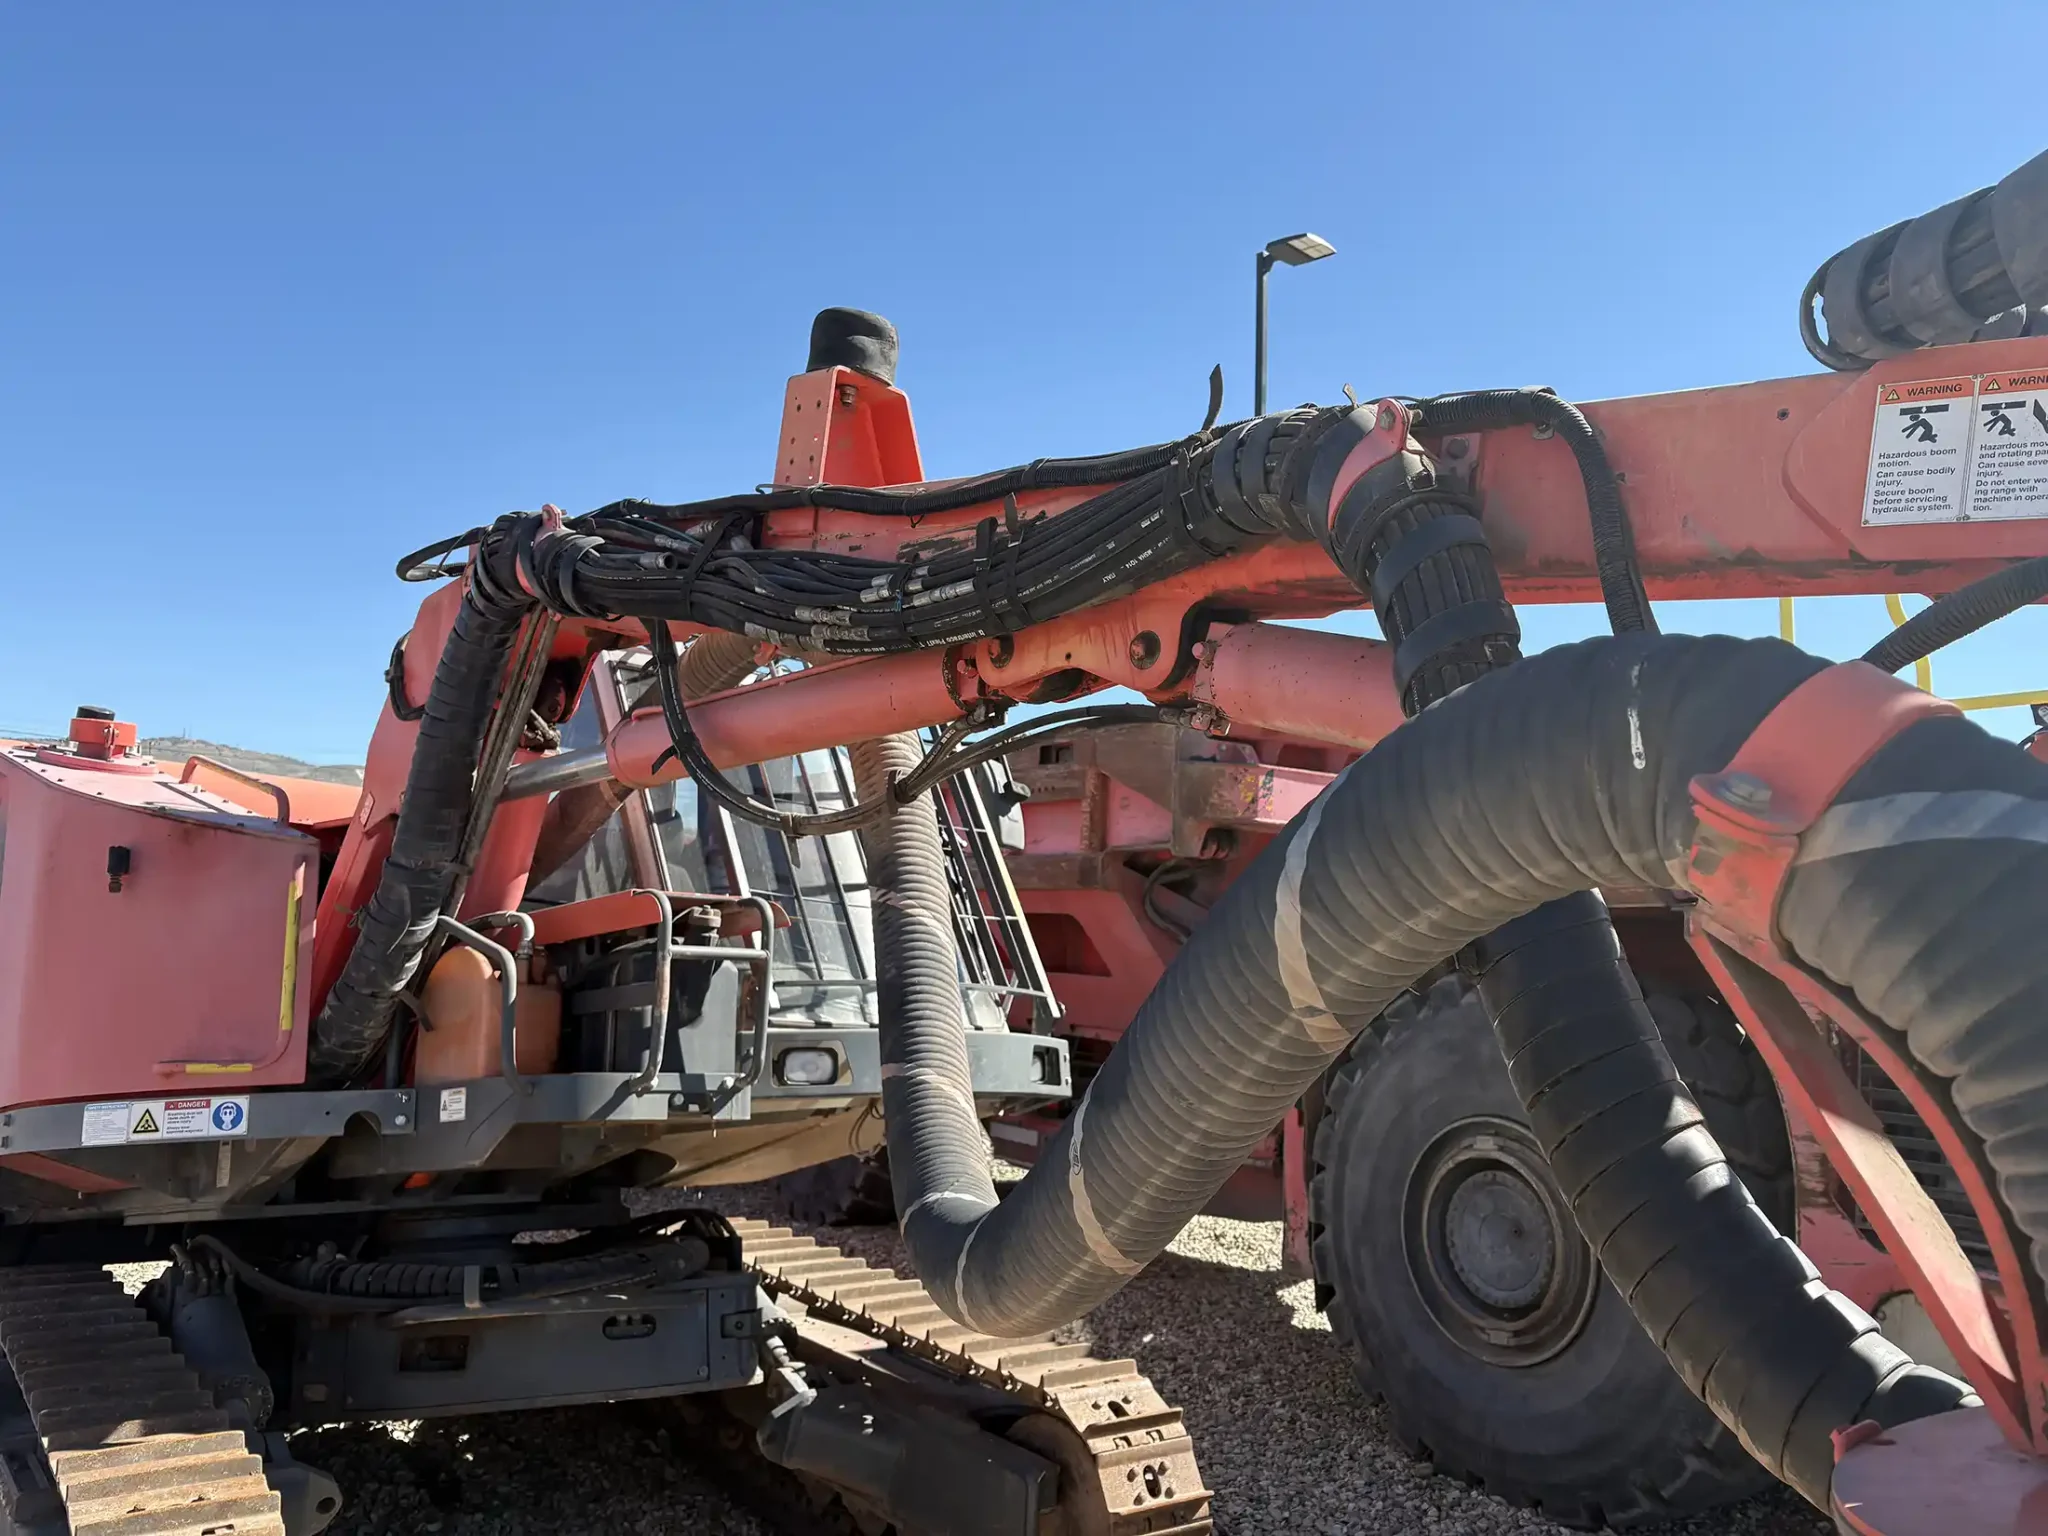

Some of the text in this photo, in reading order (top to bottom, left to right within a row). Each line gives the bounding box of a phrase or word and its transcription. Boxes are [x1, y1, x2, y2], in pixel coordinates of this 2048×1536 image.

[1907, 384, 1962, 396] WARNING
[1980, 442, 2028, 450] Hazardous
[1878, 448, 1957, 460] Hazardous boom
[1979, 451, 1996, 459] and
[1877, 460, 1911, 468] motion.
[1978, 461, 1996, 469] Can
[1897, 469, 1924, 477] cause
[1926, 466, 1956, 475] bodily
[1976, 470, 2004, 478] injury.
[1875, 479, 1903, 488] injury.
[1874, 487, 1935, 497] Secure boom
[1974, 488, 1988, 496] ing
[1990, 487, 2017, 495] range
[1873, 495, 1948, 505] before servicing
[1973, 495, 2012, 503] machine
[1872, 503, 1953, 515] hydraulic system.
[1102, 571, 1116, 584] ITALY
[178, 1101, 206, 1109] DANGER
